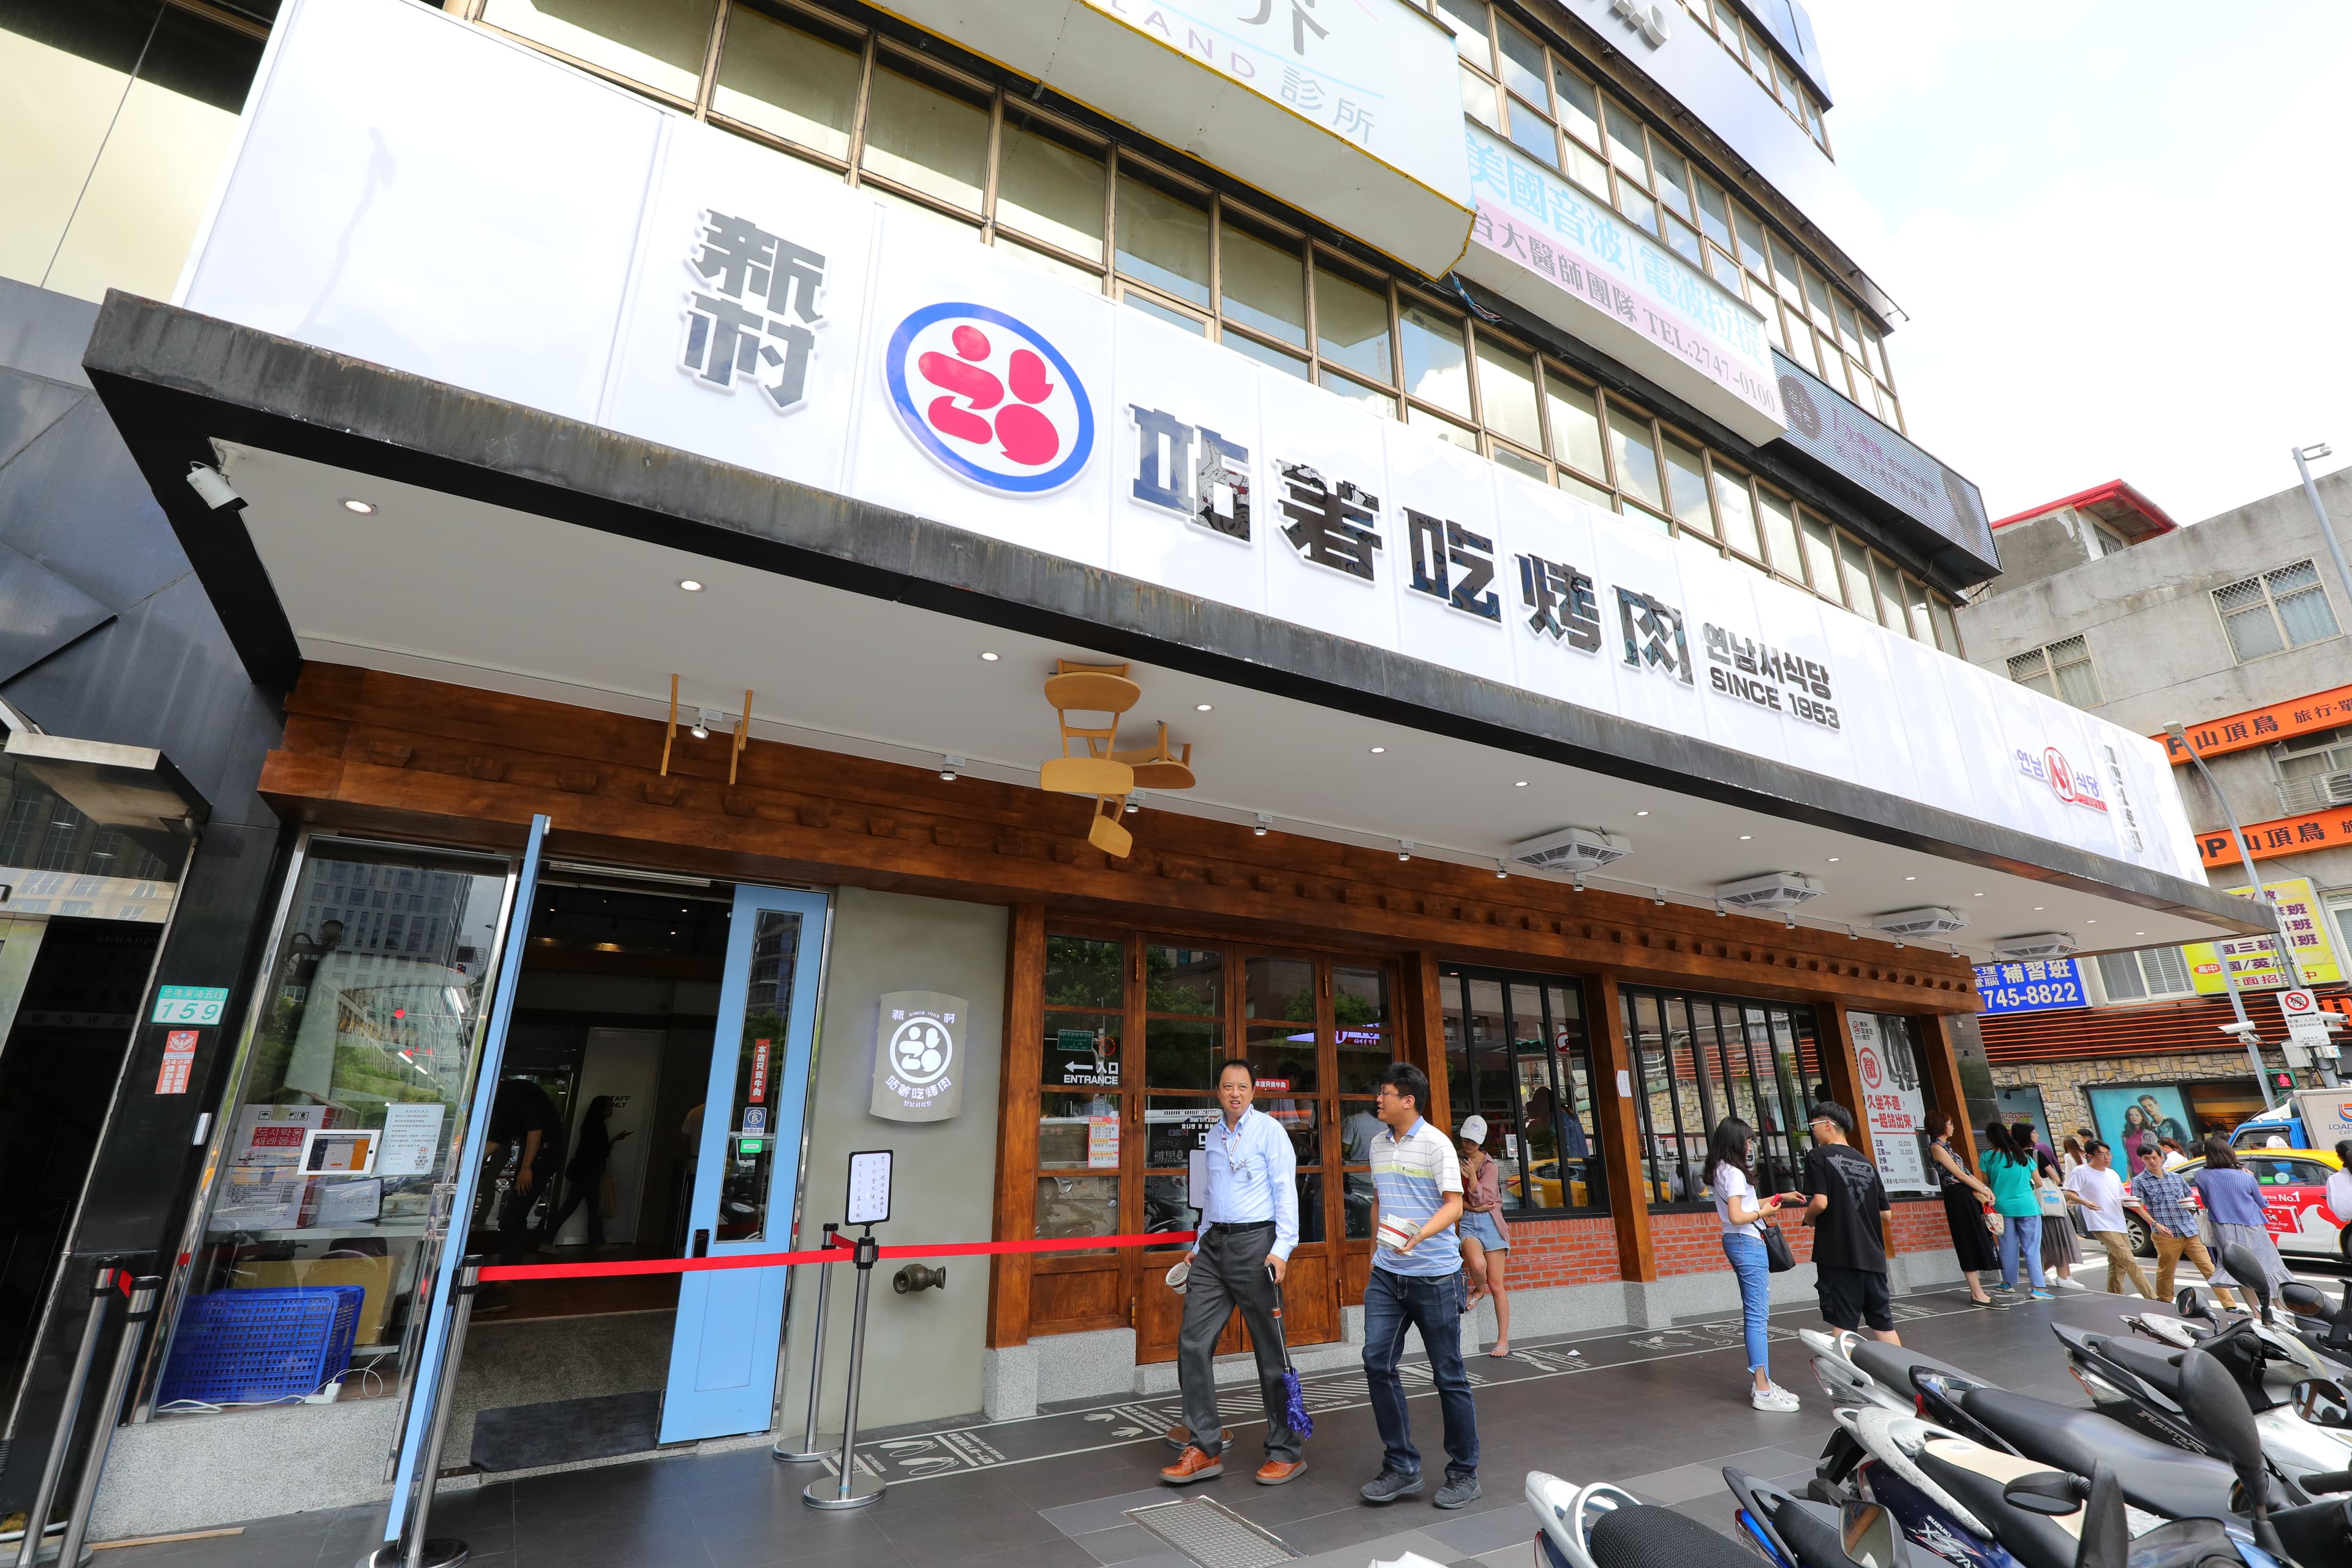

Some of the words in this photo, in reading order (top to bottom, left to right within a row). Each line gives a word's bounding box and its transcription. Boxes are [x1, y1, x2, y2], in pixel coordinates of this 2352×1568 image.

[1281, 66, 1375, 144] 診所
[1472, 204, 1638, 323] 台大醫師團隊
[684, 208, 826, 408] 新村
[1703, 622, 1833, 700] 연남서식당
[1711, 667, 1781, 710] SINCE
[1789, 693, 1840, 729] 1953
[2195, 715, 2278, 750] 山頂鳥
[2243, 823, 2326, 851] 山頂鳥
[2001, 959, 2072, 984] 補習班
[2198, 963, 2218, 973] 高中
[164, 988, 225, 999] 忠孝東路五段
[1977, 981, 2078, 1008] 745-8822
[162, 1001, 219, 1020] 159
[752, 1045, 766, 1096] 本店只賣牛肉
[1063, 1074, 1119, 1085] ENTRANCE
[1096, 1061, 1119, 1074] 入口
[254, 1137, 300, 1146] 재래돌김
[257, 1127, 303, 1137] 도시락용
[2278, 1191, 2301, 1202] No.1
[2172, 1438, 2190, 1450] 150
[1926, 1515, 1952, 1538] SUZUKI
